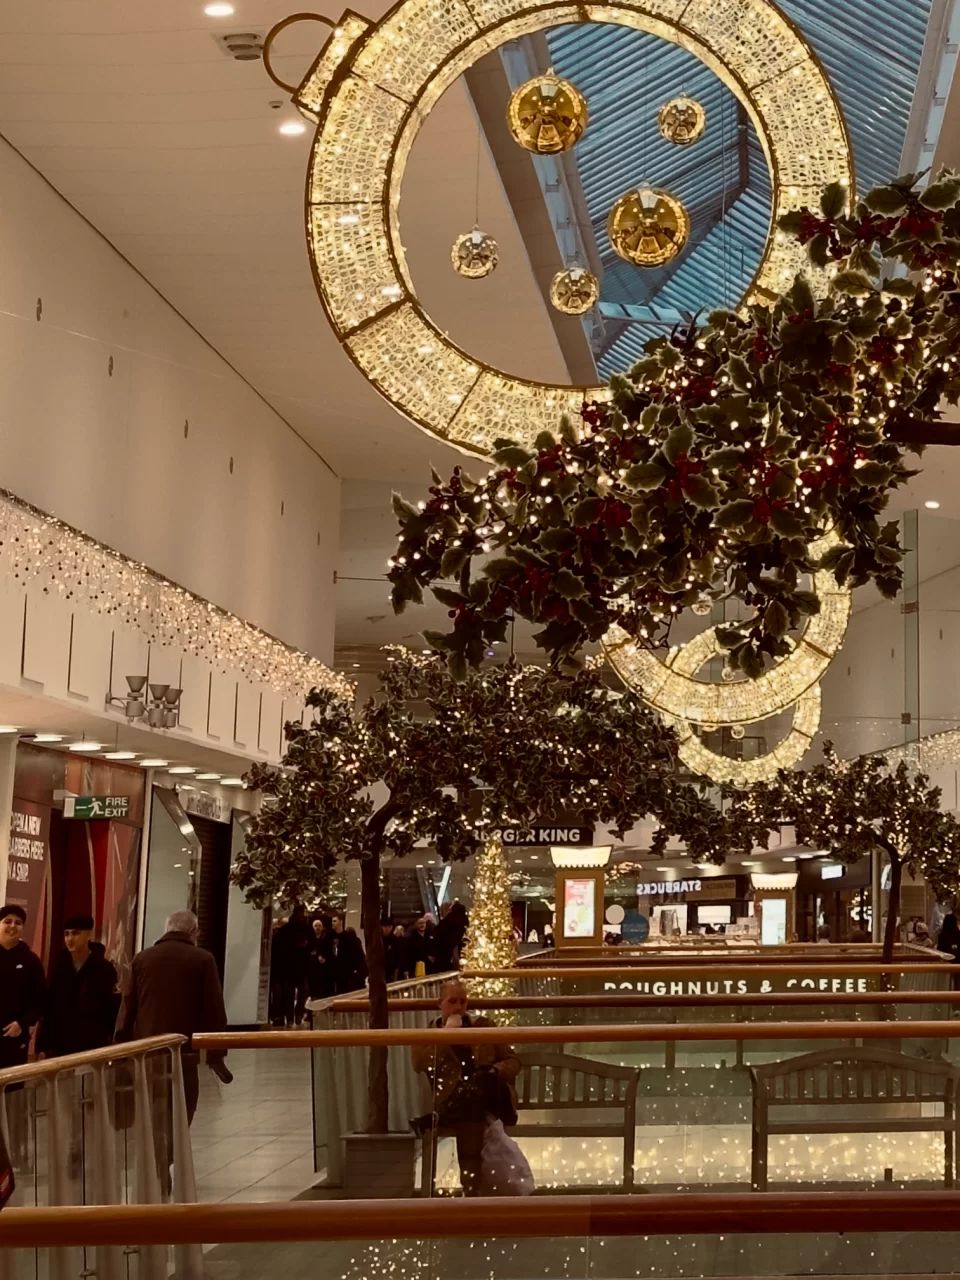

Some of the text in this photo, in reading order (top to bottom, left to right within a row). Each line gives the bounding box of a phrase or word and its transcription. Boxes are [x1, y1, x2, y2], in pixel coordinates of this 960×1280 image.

[105, 797, 128, 806] FIRE
[104, 808, 128, 817] EXIT
[28, 815, 42, 836] NEW
[539, 828, 580, 842] KING
[31, 840, 45, 861] HERE
[760, 980, 772, 994] &
